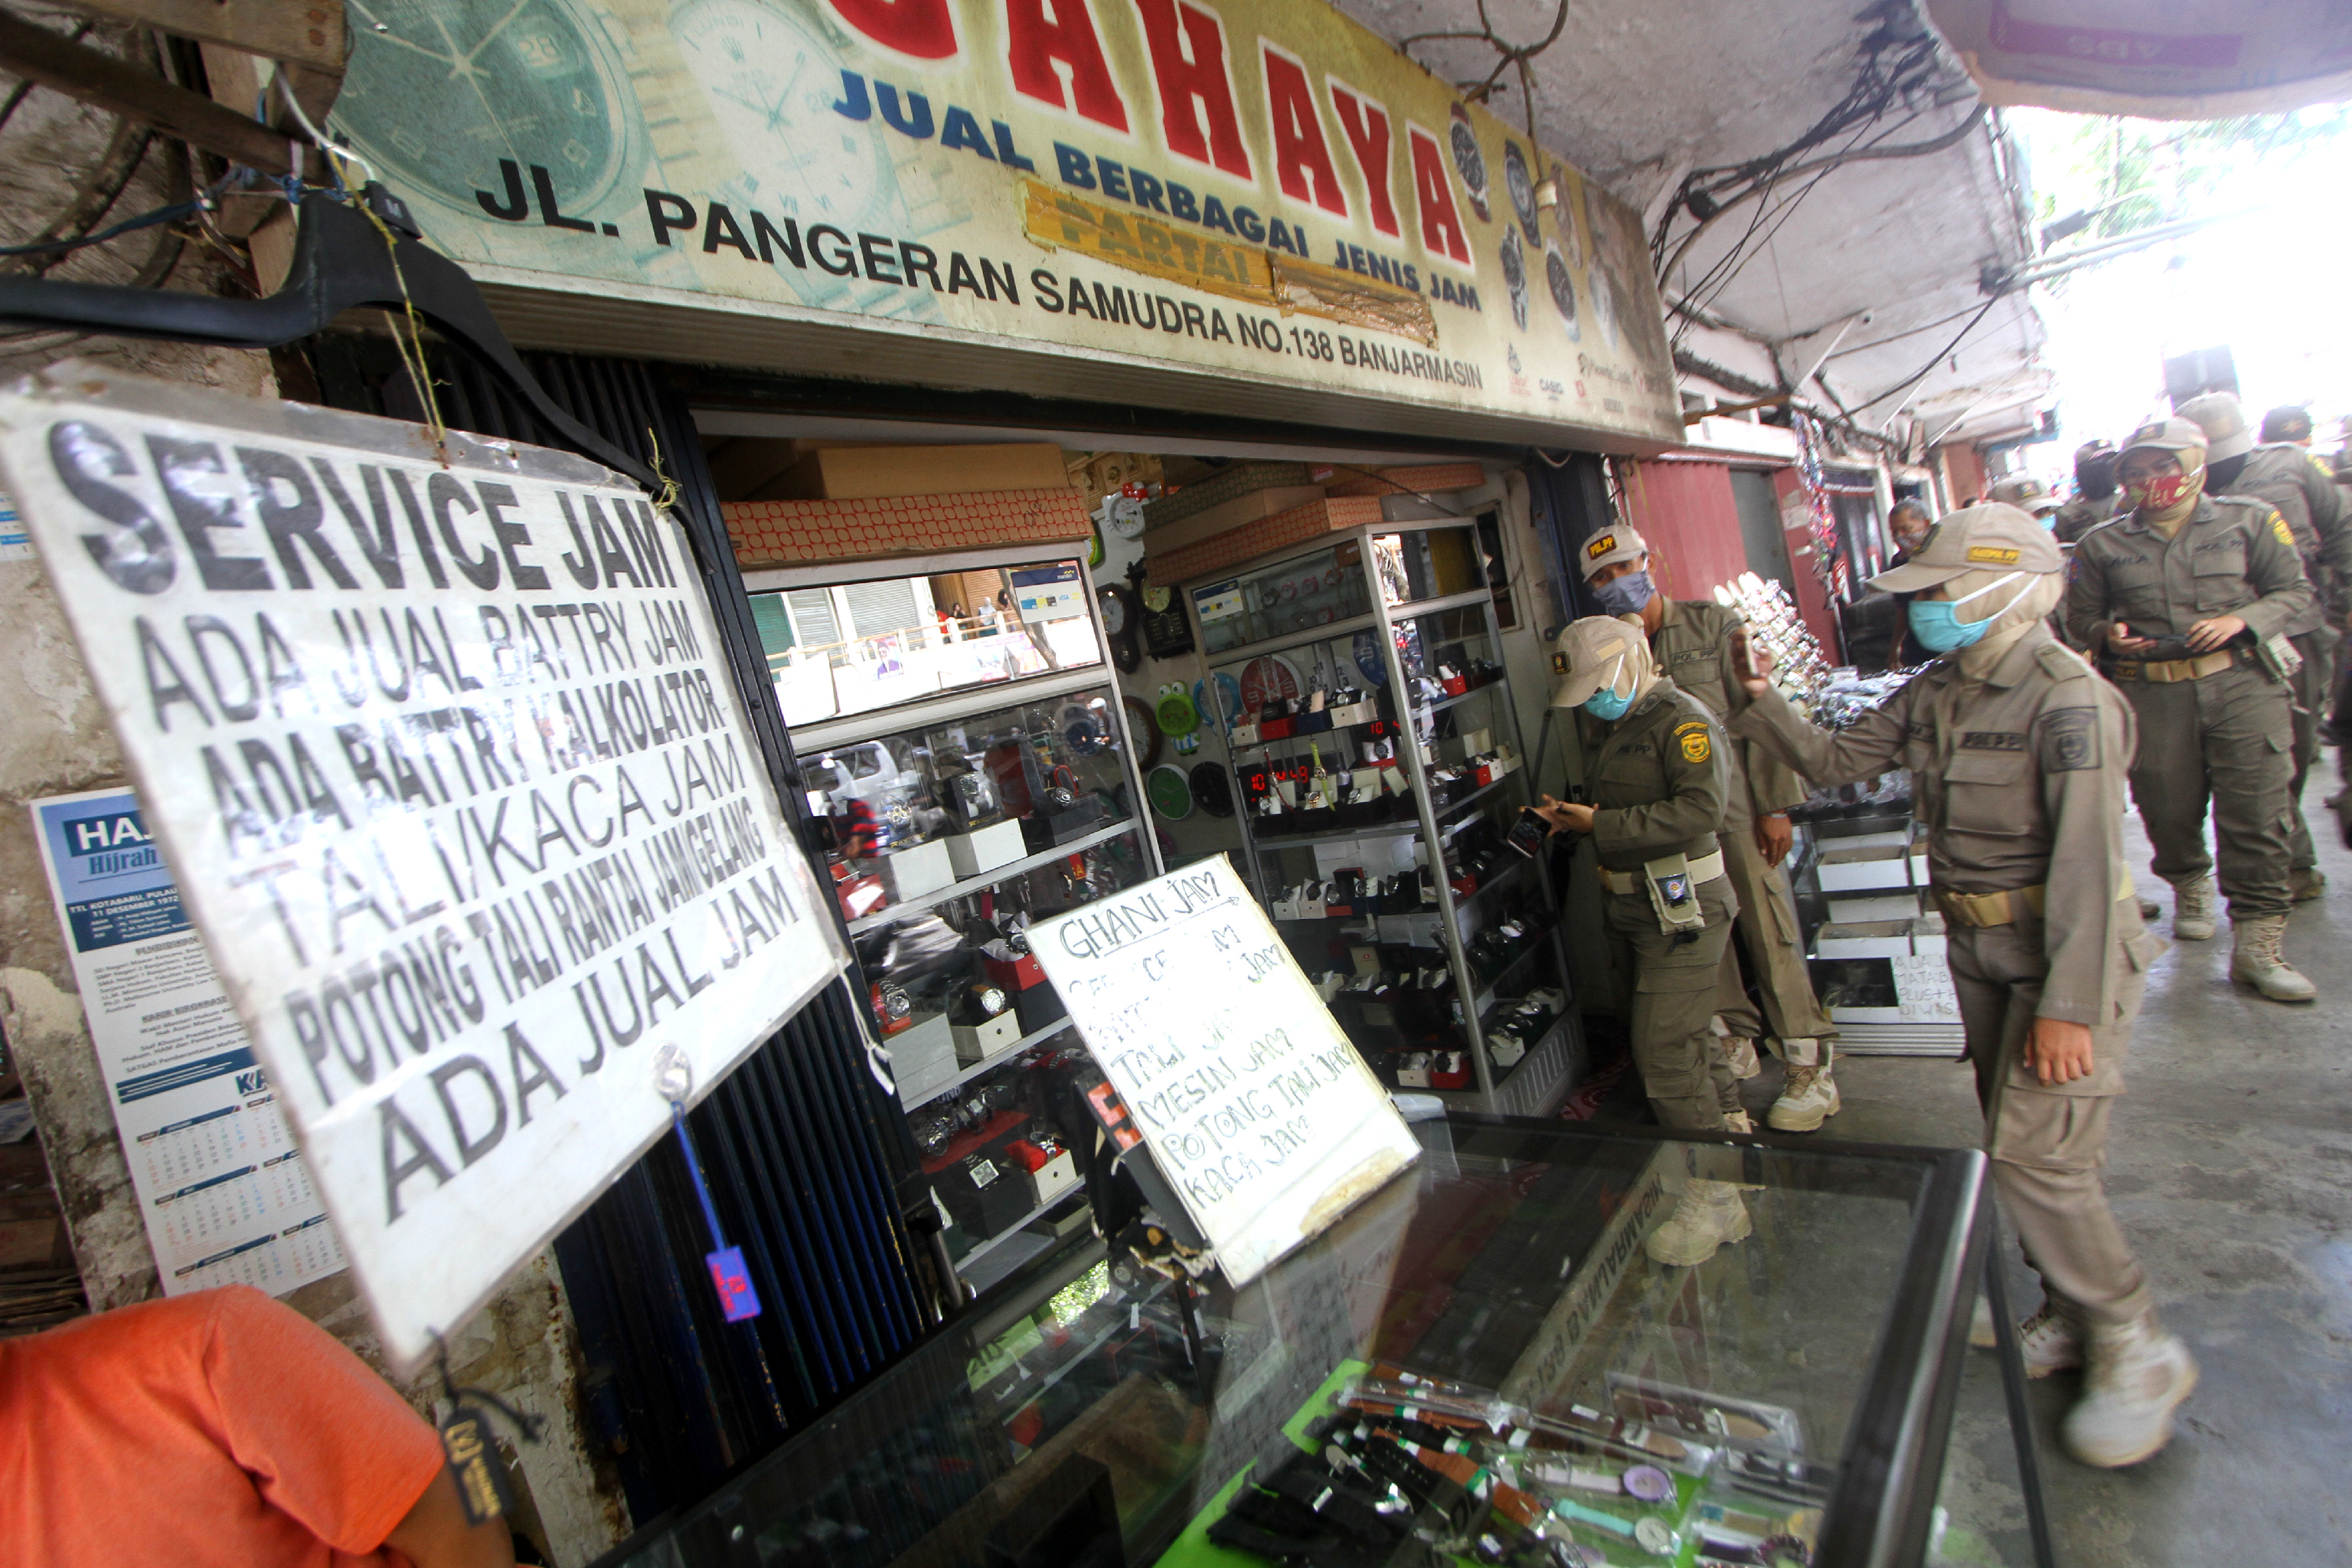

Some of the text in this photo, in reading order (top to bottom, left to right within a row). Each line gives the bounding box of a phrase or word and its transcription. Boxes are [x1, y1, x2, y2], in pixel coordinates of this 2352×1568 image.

[833, 68, 1481, 311] JUAL BERBAGAI JENIS JAM
[475, 158, 1483, 389] JL. PANGERAN SAMUDRA NO.138 BANJARMASIN
[1055, 198, 1251, 285] PARTAI
[49, 420, 678, 594] SERVICE JAM
[133, 600, 703, 733] ADA JUAL BATTRY JAM
[1674, 653, 1695, 662] POL
[1371, 722, 1384, 734] 10
[201, 731, 353, 860] ADA
[663, 733, 747, 817] JAM
[1251, 773, 1265, 791] 10
[76, 817, 155, 850] HA
[89, 847, 159, 875] Hijrah
[105, 900, 156, 915] DESEMBER
[157, 895, 179, 906] 1972
[1059, 892, 1170, 959] GHANI
[1167, 871, 1221, 914] JAM
[285, 925, 485, 1108] POTONG
[465, 889, 563, 1005] TALI
[542, 847, 654, 966] RANTAI
[1241, 943, 1285, 984] JAM
[375, 865, 799, 1226] ADA JUAL JAM
[1110, 1035, 1186, 1089] TALI
[1138, 1057, 1237, 1130] MESIN
[1241, 1028, 1294, 1072] JAM
[1161, 1089, 1277, 1171] POTONG
[1311, 1042, 1356, 1082] JAM
[1184, 1115, 1316, 1209] KACA JAM
